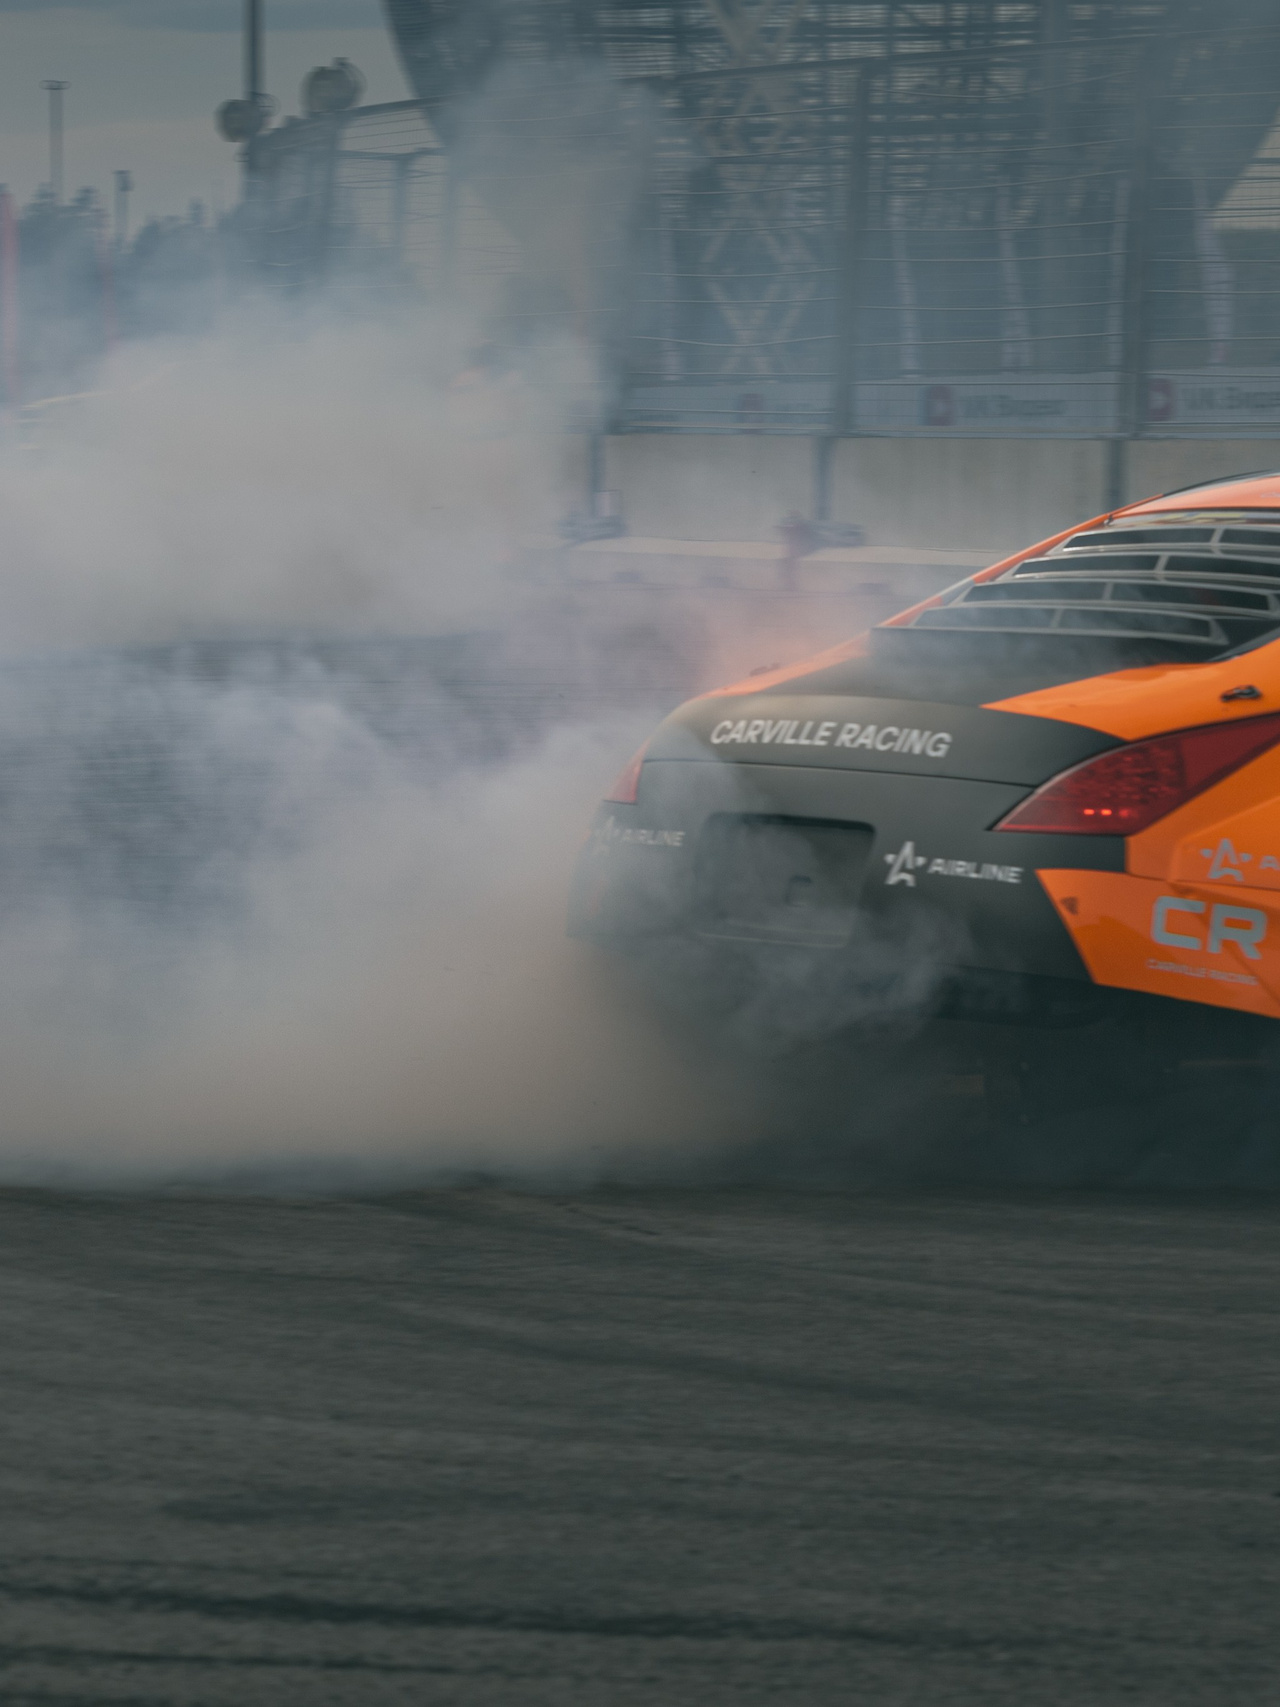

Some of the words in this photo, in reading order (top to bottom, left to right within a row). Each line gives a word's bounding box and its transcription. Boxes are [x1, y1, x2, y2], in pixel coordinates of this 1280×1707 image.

[709, 719, 834, 747] CARVILLE
[835, 721, 953, 759] RACING
[927, 858, 1025, 884] AIRLINE
[1151, 895, 1268, 960] CR
